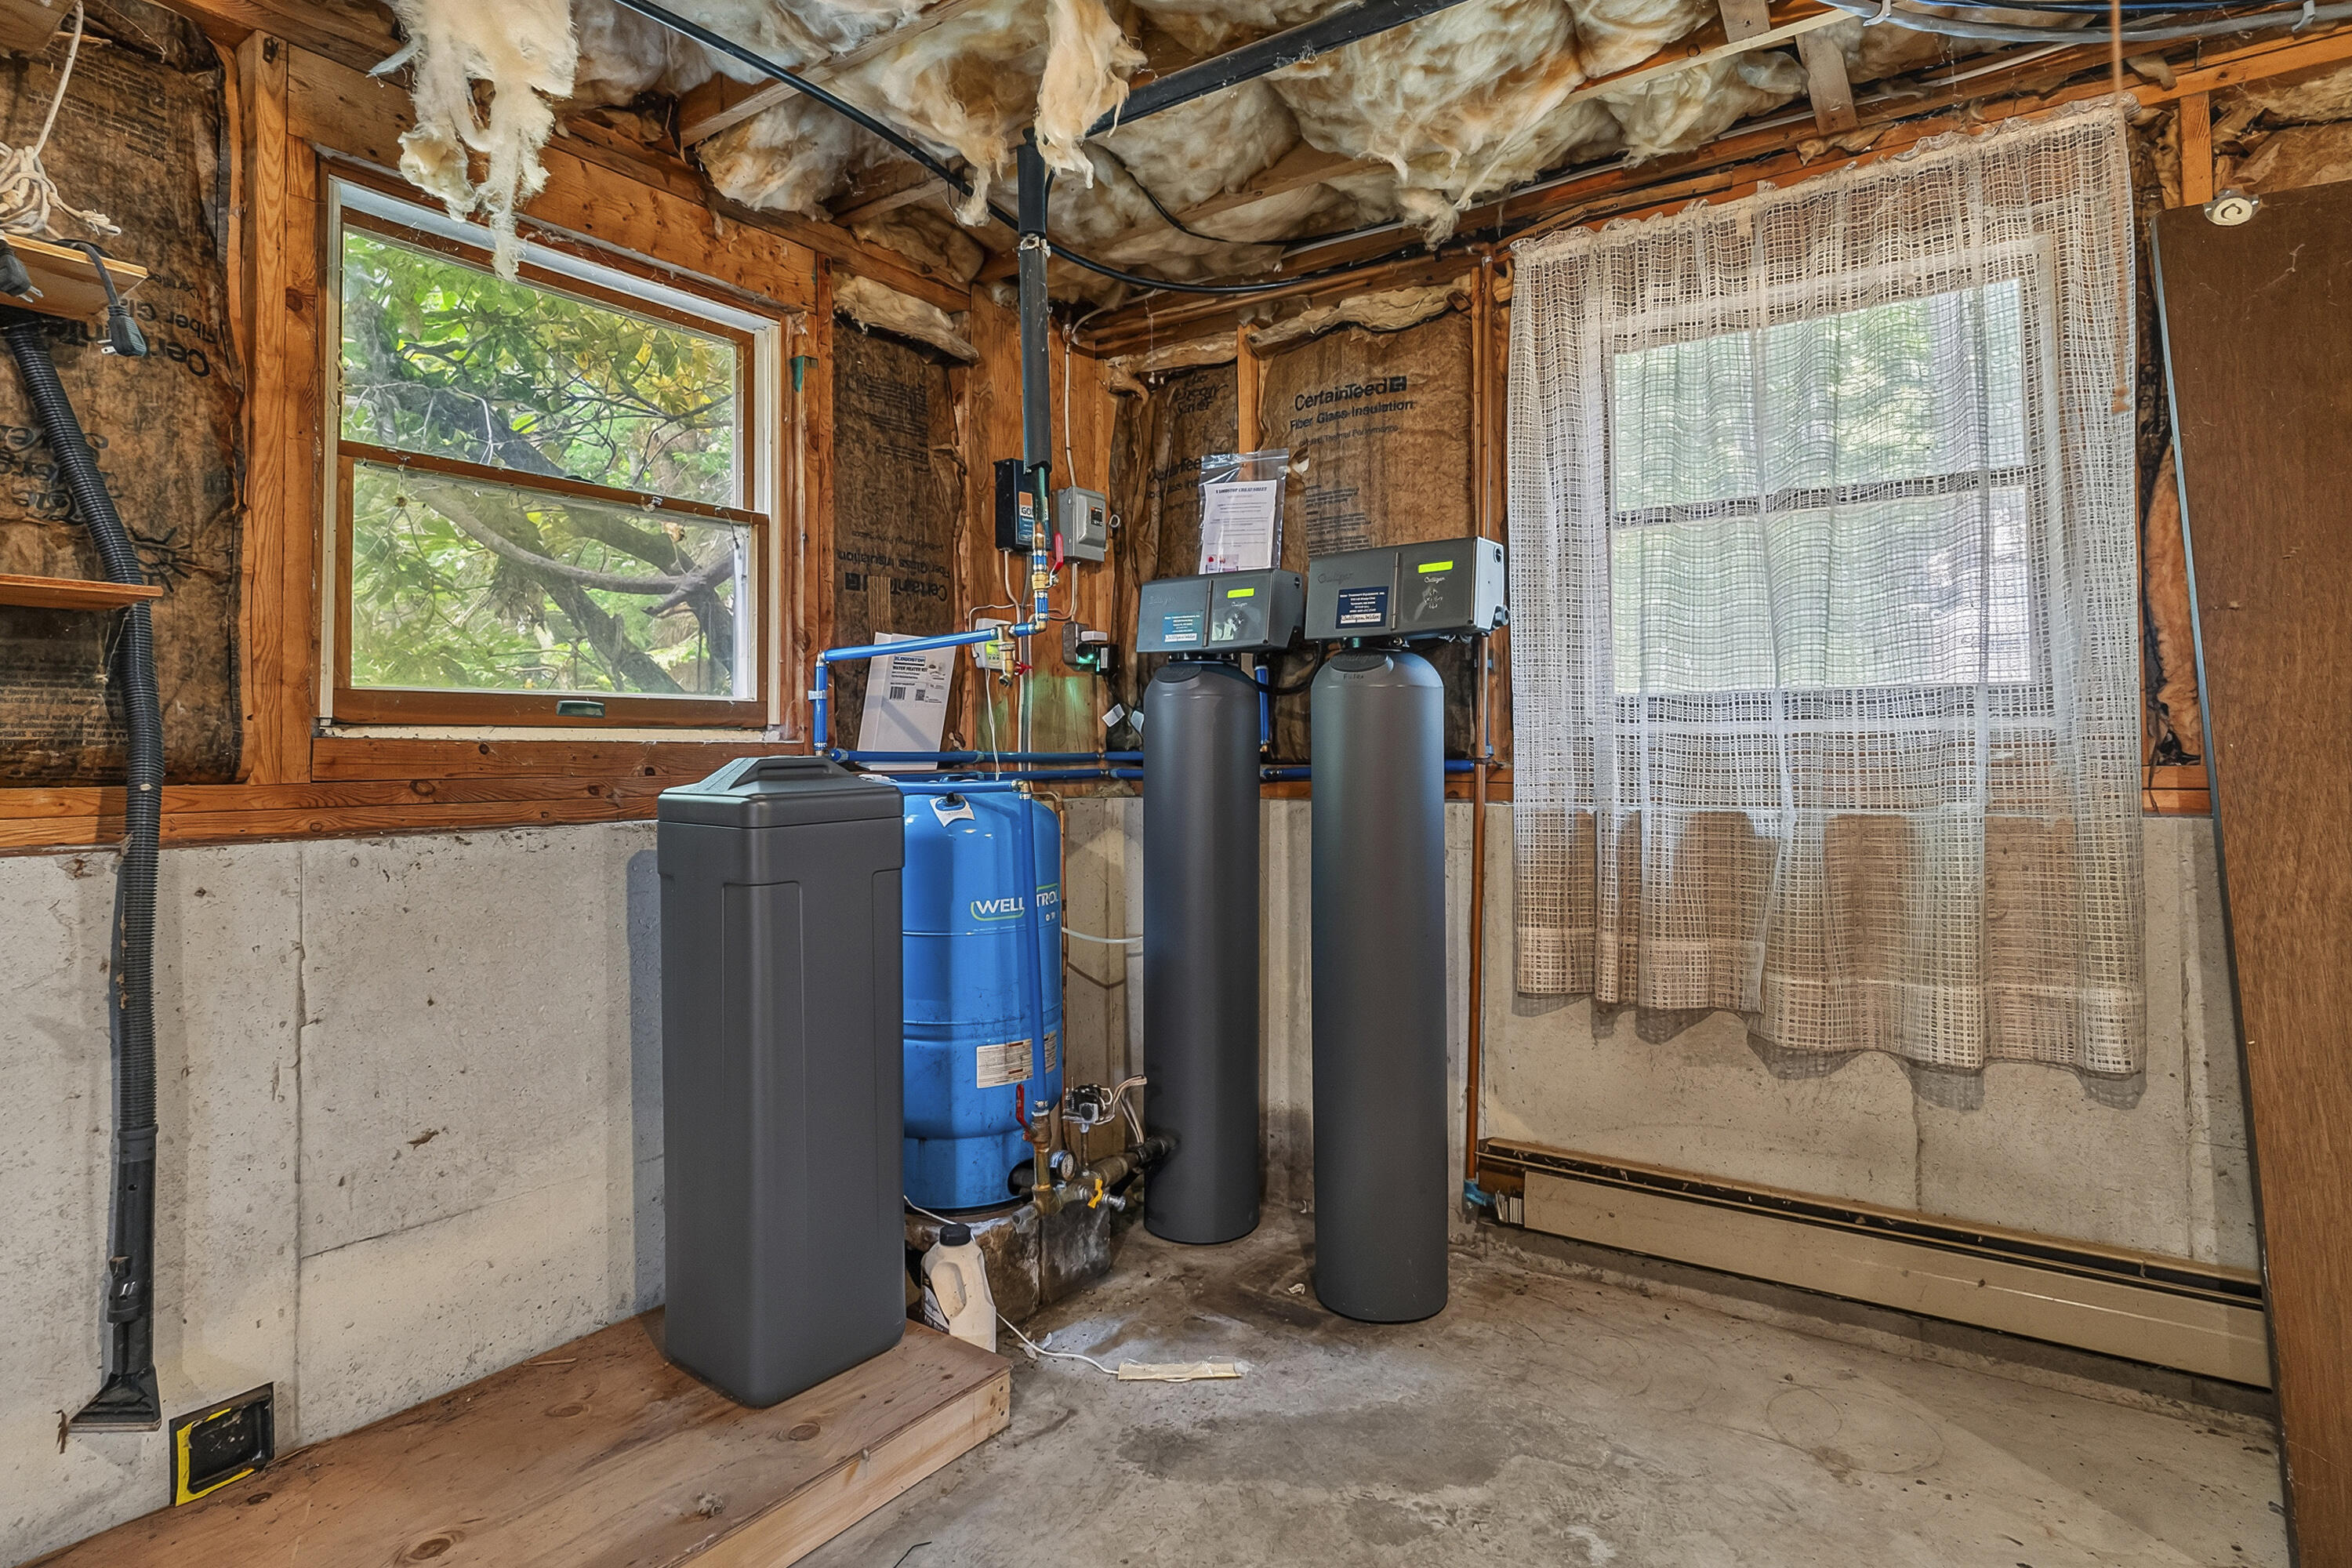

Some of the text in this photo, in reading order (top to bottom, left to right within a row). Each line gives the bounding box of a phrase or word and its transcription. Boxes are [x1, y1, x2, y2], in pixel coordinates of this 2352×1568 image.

[165, 311, 218, 345] Fiber
[1294, 377, 1388, 412] CertainTeed
[1289, 401, 1414, 432] Fiber Glass Insulation
[898, 559, 928, 575] Glass
[931, 564, 951, 579] Fiber
[863, 574, 948, 602] CertainTd
[975, 896, 1025, 915] WELL
